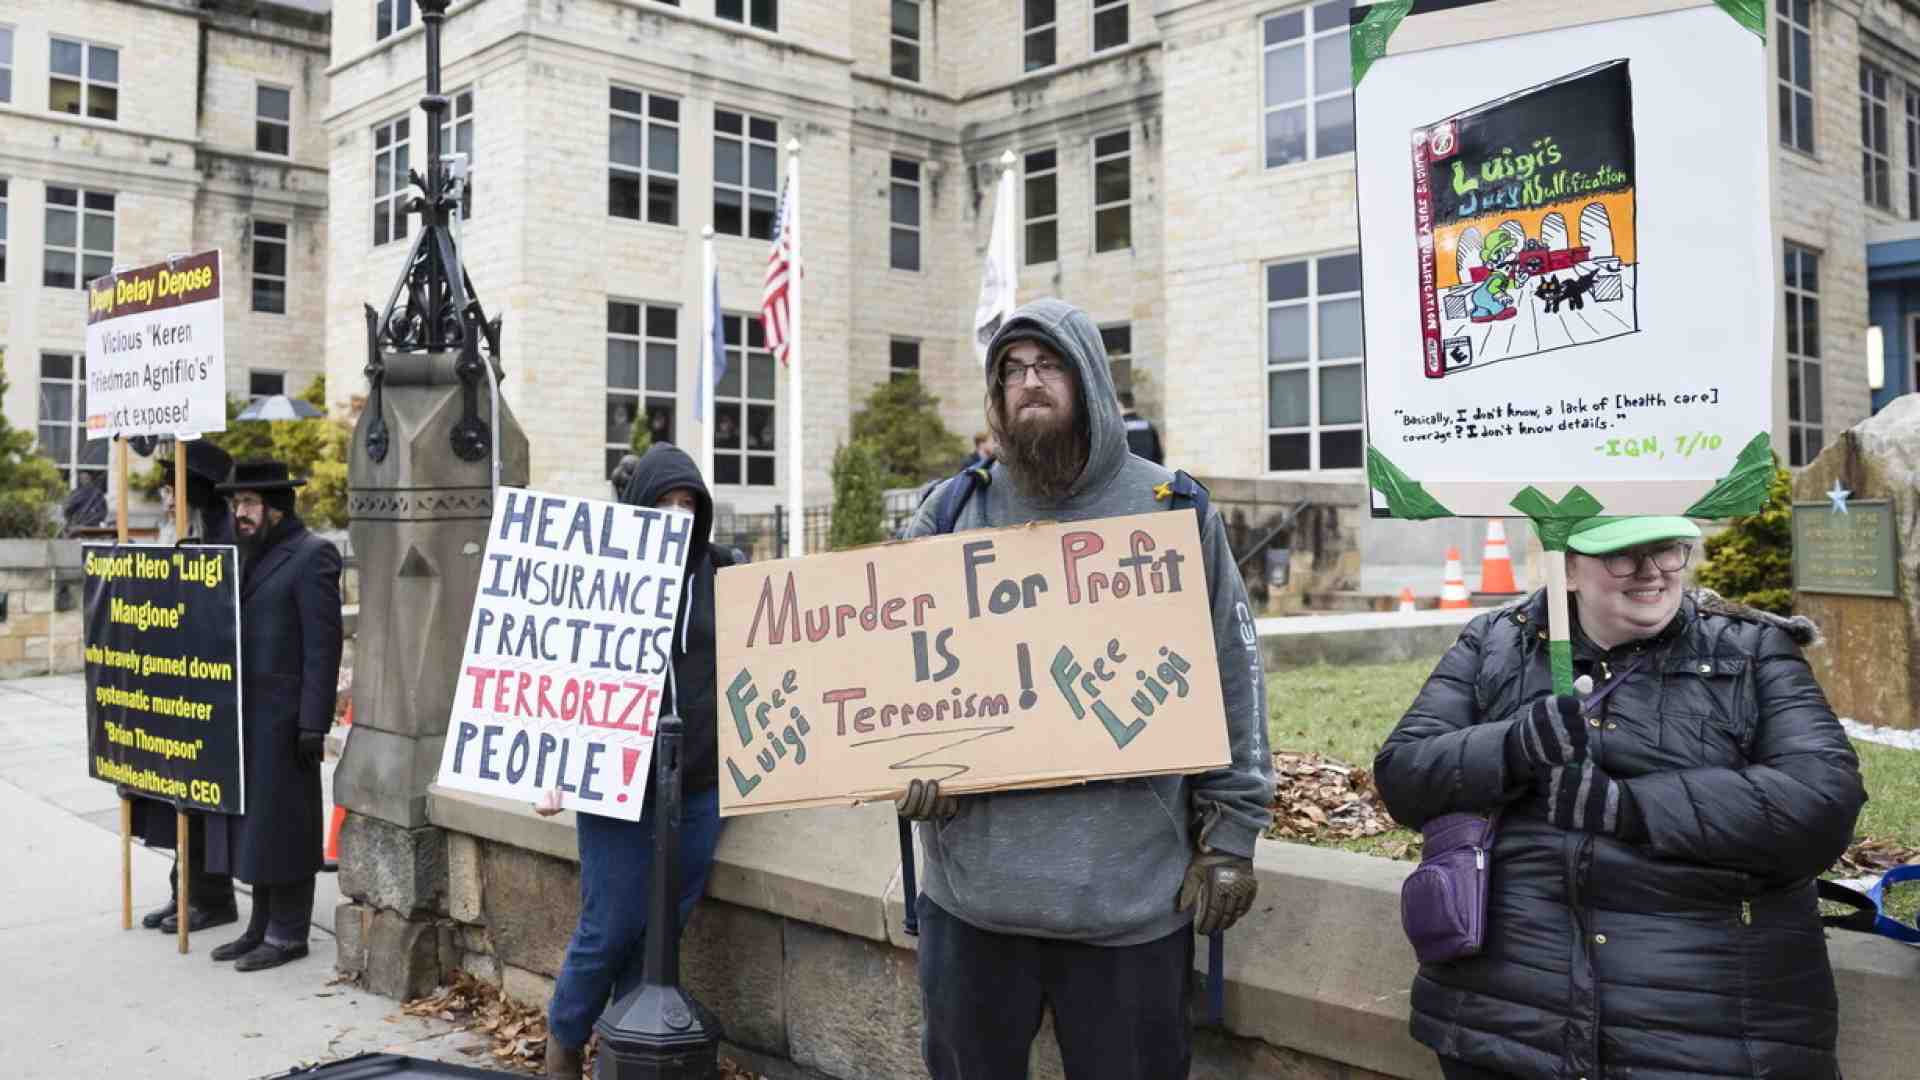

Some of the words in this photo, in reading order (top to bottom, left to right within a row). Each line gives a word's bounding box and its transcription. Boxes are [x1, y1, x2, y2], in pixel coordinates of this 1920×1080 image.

[1452, 137, 1562, 195] Luigi's
[1457, 184, 1521, 216] Jury
[1523, 164, 1627, 206] Nullification
[1418, 198, 1430, 235] JURY
[116, 276, 155, 305] Delay
[158, 265, 213, 299] Depose
[1419, 236, 1437, 330] ULLIFICATION
[102, 330, 143, 354] Vicious
[147, 323, 193, 346] "Keren
[1450, 346, 1468, 363] E
[91, 368, 140, 393] Friedman
[133, 398, 189, 430] exposed
[1456, 408, 1467, 422] I
[1473, 405, 1502, 420] don't
[1507, 402, 1540, 419] know,
[1545, 405, 1553, 415] a
[1560, 398, 1588, 414] lack
[1592, 396, 1609, 411] of
[1616, 393, 1666, 409] [health
[1673, 388, 1719, 404] care]
[1467, 424, 1478, 438] I
[1481, 424, 1513, 437] don't
[1519, 422, 1553, 435] know
[1675, 431, 1723, 457] 7/10
[499, 492, 692, 567] HEALTH
[85, 552, 133, 581] Support
[136, 553, 170, 580] Hero
[173, 553, 223, 588] "Luigi
[482, 553, 677, 620] INSURANCE
[746, 561, 936, 648] Murder
[962, 539, 1049, 619] For
[1061, 529, 1186, 605] Profit
[111, 597, 185, 631] Mangione"
[473, 607, 673, 675] PRACTICES
[85, 645, 104, 666] who
[104, 645, 141, 674] bravely
[142, 654, 187, 677] gunned
[190, 656, 232, 681] down
[1049, 637, 1128, 720] Free
[96, 684, 150, 712] systematic
[152, 695, 213, 721] murderer
[466, 667, 660, 737] TERRORIZE
[725, 667, 798, 747] Free
[1089, 645, 1193, 750] Luigi
[104, 721, 134, 748] "Brian
[135, 727, 203, 760] Thompson"
[726, 705, 811, 798] Luigi
[96, 755, 188, 798] UnitedHealthcare
[190, 779, 221, 806] CEO
